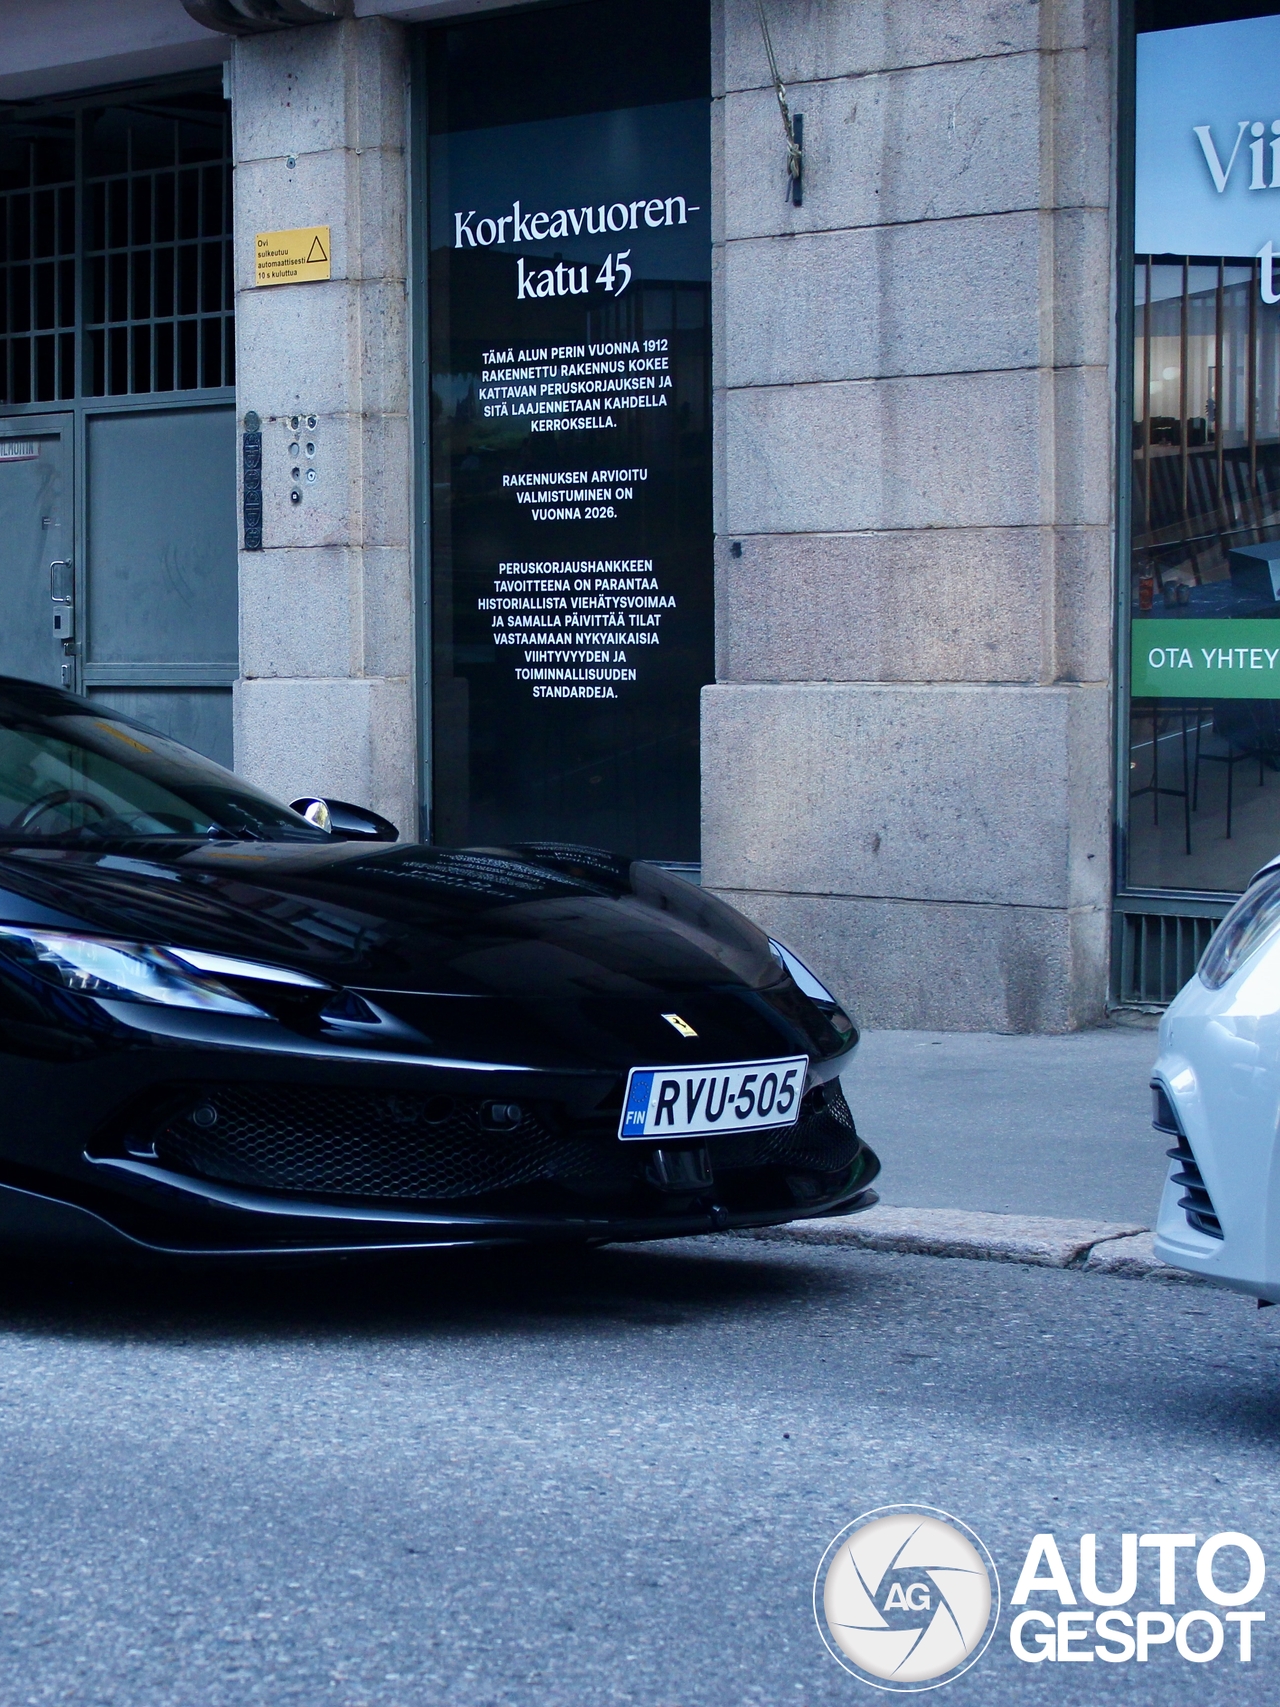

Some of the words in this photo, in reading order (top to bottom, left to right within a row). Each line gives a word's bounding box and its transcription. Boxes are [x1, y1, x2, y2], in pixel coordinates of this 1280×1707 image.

[454, 195, 700, 249] Korkeavuoren-
[257, 240, 268, 248] Ovi
[257, 249, 289, 259] sulkeutuu
[257, 257, 306, 269] automaattisesti
[272, 270, 298, 278] kuluttua
[516, 257, 589, 300] katu
[595, 249, 632, 297] 45
[482, 348, 515, 365] TÄMÄ
[517, 347, 548, 363] ALUN
[550, 345, 586, 360] PERIN
[588, 341, 640, 357] VUONNA
[642, 338, 669, 352] 1912
[482, 365, 558, 383] RAKENNETTU
[560, 361, 626, 377] RAKENNUS
[628, 356, 669, 372] KOKEE
[479, 384, 537, 400] KATTAVAN
[540, 376, 656, 397] PERUSKORJAUKSEN
[657, 375, 673, 388] JA
[483, 400, 509, 418] SITÄ
[511, 398, 601, 416] LAAJENNETAAN
[604, 394, 668, 410] KAHDELLA
[530, 415, 618, 433] KERROKSELLA.
[502, 471, 588, 487] RAKENNUKSEN
[591, 468, 648, 484] ARVIOITU
[516, 488, 612, 504] VALMISTUMINEN
[615, 487, 633, 500] ON
[531, 507, 582, 522] VUONNA
[584, 506, 618, 520] 2026.
[498, 559, 654, 575] PERUSKORJAUSHANKKEEN
[493, 579, 571, 593] TAVOITTEENA
[573, 578, 592, 592] ON
[594, 577, 659, 591] PARANTAA
[477, 597, 568, 611] HISTORIALLISTA
[570, 594, 677, 609] VIEHÄTYSVOIMAA
[491, 615, 505, 628] JA
[507, 614, 562, 628] SAMALLA
[564, 611, 626, 627] PÄIVITTÄÄ
[628, 613, 662, 627] TILAT
[493, 632, 573, 645] VASTAAMAAN
[575, 632, 660, 645] NYKYAIKAISIA
[524, 650, 610, 663] VIIHTYVYYDEN
[612, 650, 627, 663] JA
[1148, 647, 1194, 669] OTA
[1201, 647, 1280, 670] YHTEY
[514, 667, 637, 681] TOIMINNALLISUUDEN
[532, 685, 618, 699] STANDARDEJA.
[653, 1069, 798, 1127] RVU-505
[625, 1110, 646, 1125] FIN
